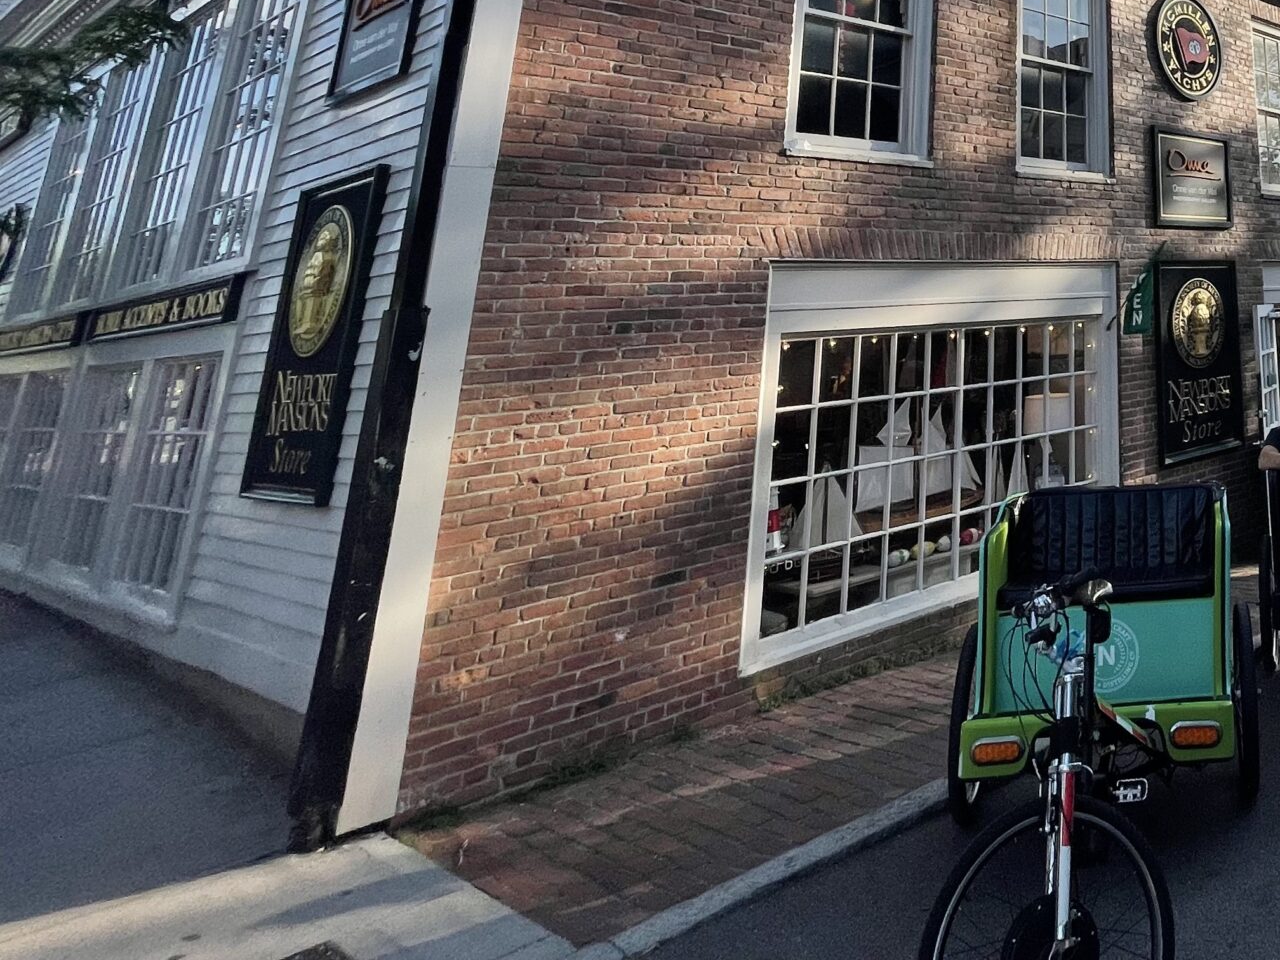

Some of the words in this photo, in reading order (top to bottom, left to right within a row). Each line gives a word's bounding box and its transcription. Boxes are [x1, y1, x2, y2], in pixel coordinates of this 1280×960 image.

[1168, 59, 1213, 90] YACHTS
[169, 298, 182, 323] &
[182, 287, 229, 320] BOOKS
[273, 370, 338, 406] NEWPORT
[1168, 375, 1231, 400] NEWPORT
[1168, 397, 1231, 424] MANSIONS
[1182, 419, 1223, 443] Store
[269, 438, 312, 474] Store
[1097, 644, 1115, 667] N
